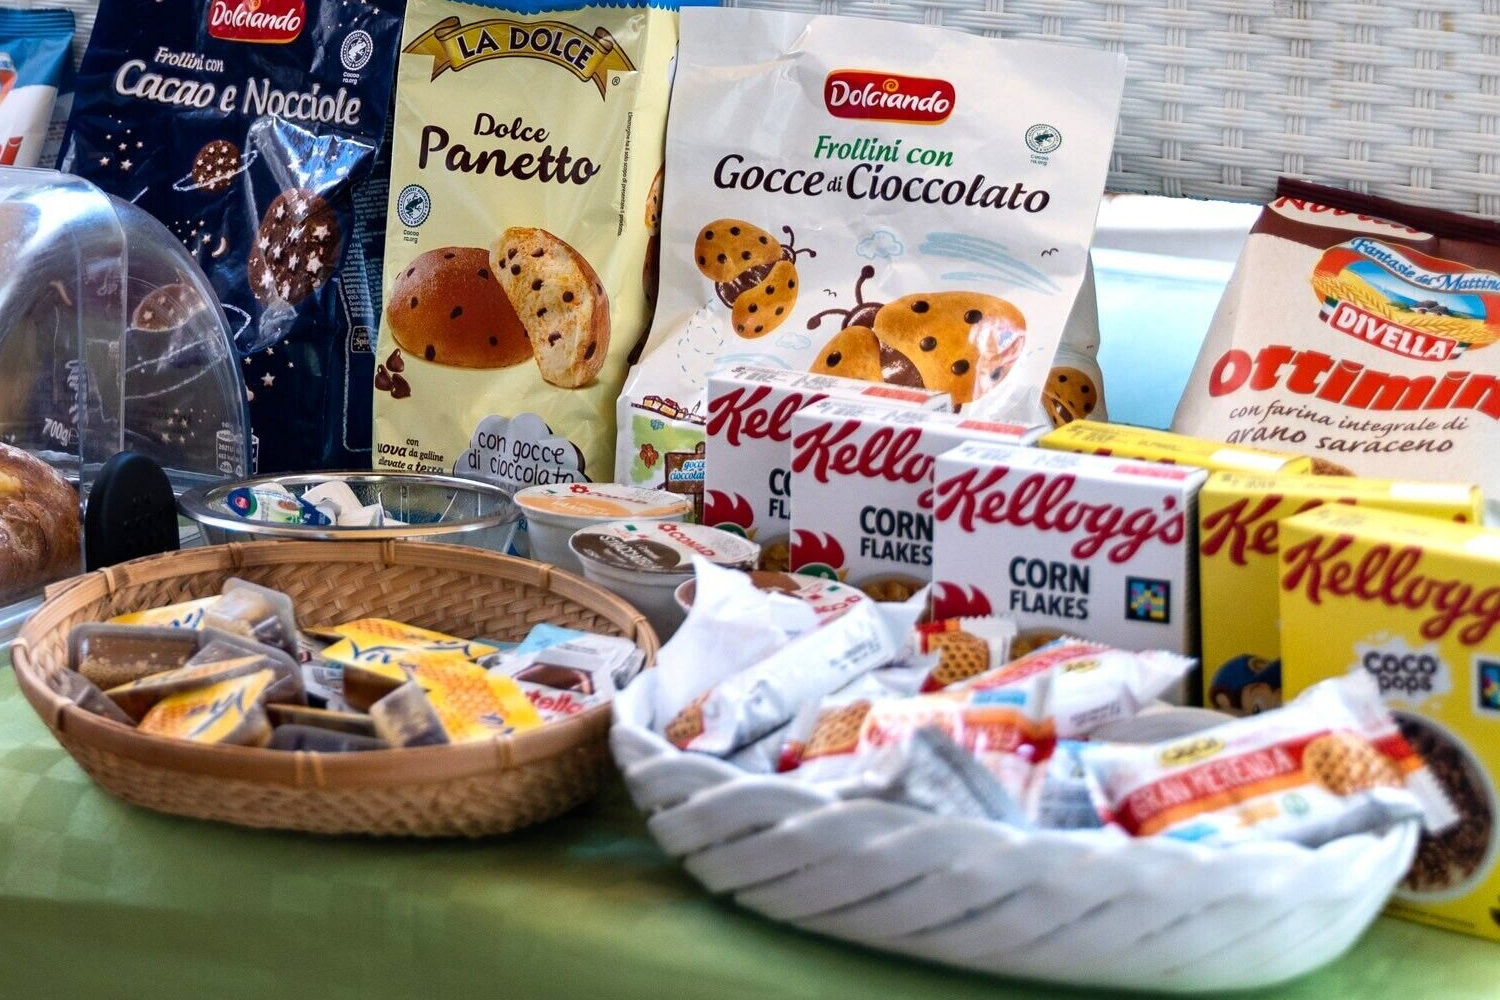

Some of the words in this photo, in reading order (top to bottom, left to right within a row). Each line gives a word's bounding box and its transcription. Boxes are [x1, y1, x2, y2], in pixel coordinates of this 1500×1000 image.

[211, 0, 301, 32] Dolciando
[154, 47, 204, 71] Frollini
[204, 56, 225, 73] con
[456, 29, 500, 61] LA
[508, 26, 595, 71] DOLCE
[115, 58, 216, 108] Cacao
[220, 84, 237, 111] e
[242, 76, 363, 126] Nocciole
[829, 80, 950, 114] Dolciando
[473, 112, 550, 143] Dolce
[418, 124, 601, 186] Panetto
[813, 135, 902, 163] Frollini
[906, 147, 954, 168] con
[713, 153, 826, 196] Gocce
[826, 175, 843, 193] di
[846, 162, 1051, 214] Cioccolato
[1351, 237, 1417, 279] Fantasie
[1336, 305, 1449, 362] DIVELLA
[1229, 402, 1264, 420] con
[1261, 400, 1338, 427] farina
[1338, 415, 1440, 438] integrale
[1442, 417, 1469, 432] di
[377, 443, 407, 458] uova
[408, 449, 419, 458] da
[419, 450, 444, 463] galline
[406, 437, 420, 448] con
[468, 448, 481, 471] di
[478, 431, 506, 453] con
[512, 439, 565, 465] gocce
[1315, 435, 1454, 454] saraceno
[860, 505, 933, 543] CORN
[934, 465, 1185, 564] Kellogg's
[860, 537, 933, 567] FLAKES
[1009, 556, 1090, 594] CORN
[1009, 590, 1089, 621] FLAKES
[1192, 745, 1297, 794] MERENDA
